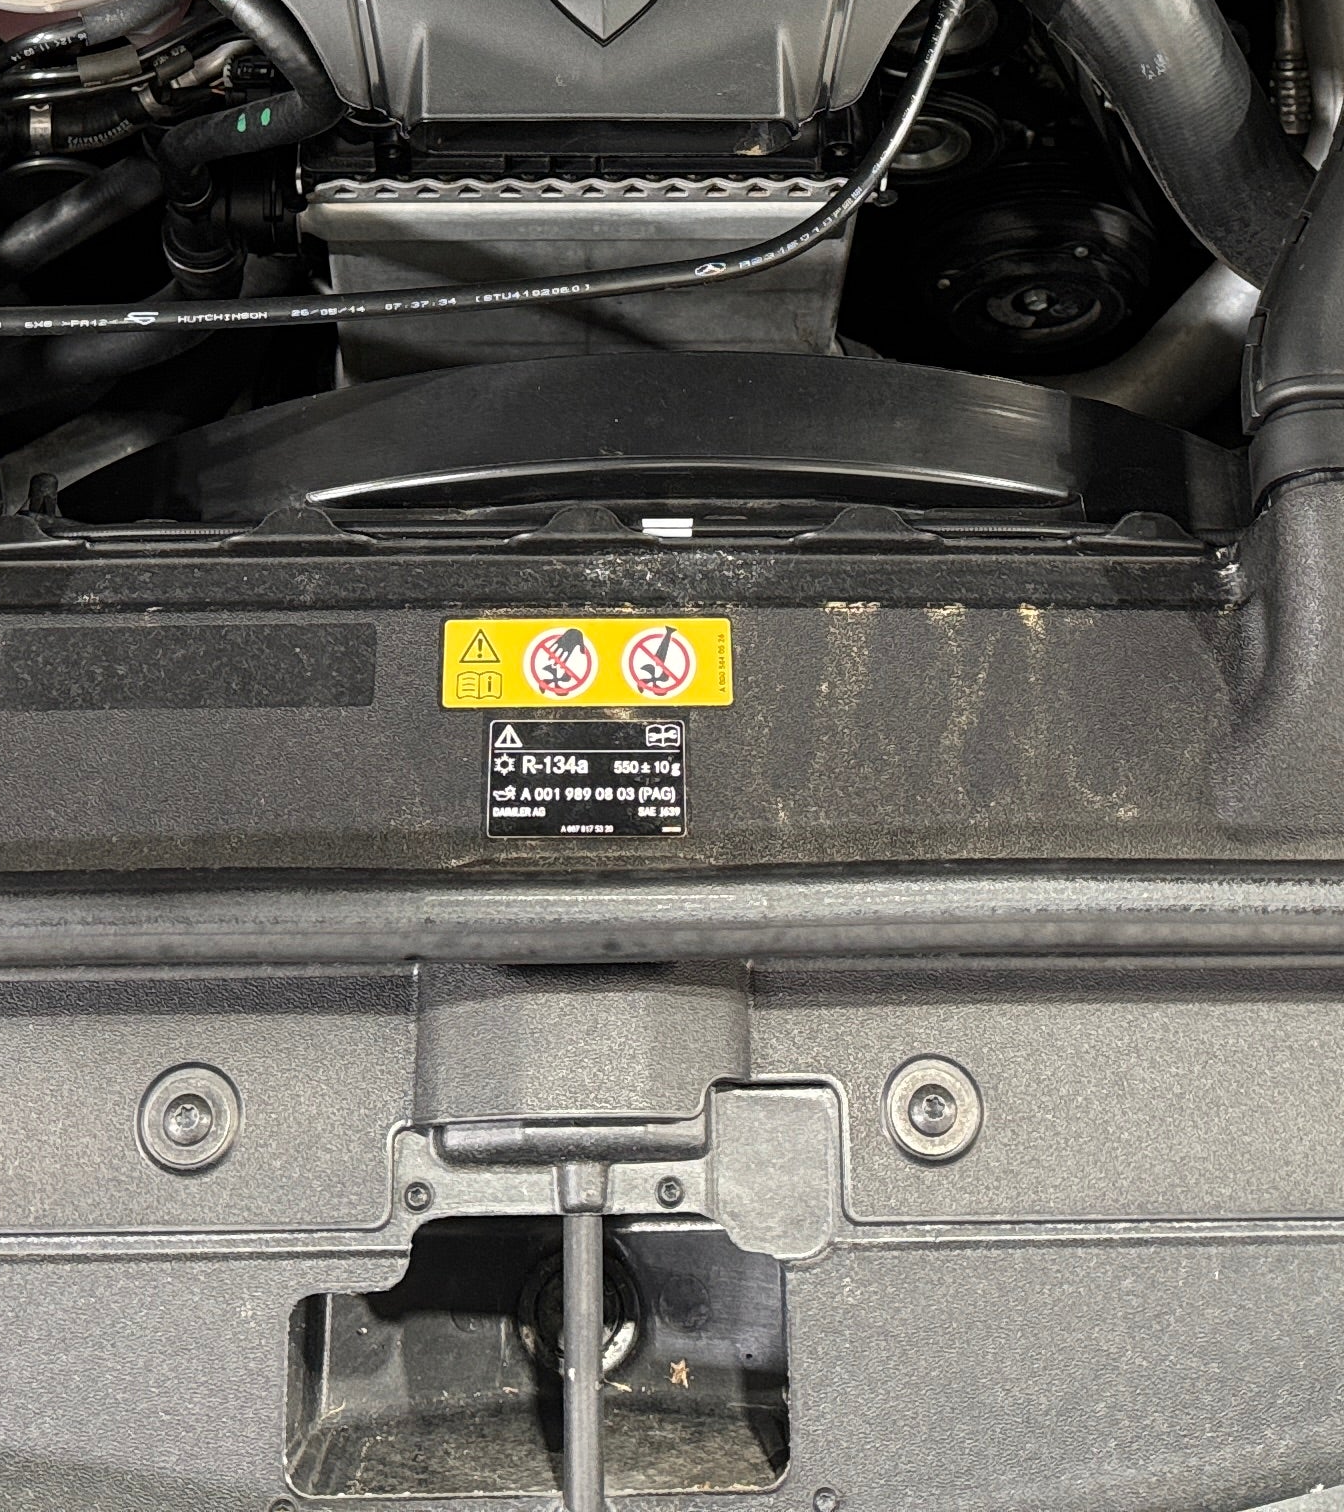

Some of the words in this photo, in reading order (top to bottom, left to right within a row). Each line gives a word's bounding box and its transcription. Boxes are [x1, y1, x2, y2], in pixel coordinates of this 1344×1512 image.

[178, 311, 268, 324] HUTCHINSON
[522, 755, 589, 774] R-134a
[613, 760, 639, 774] 550
[654, 760, 670, 774] 10
[520, 787, 532, 801] A
[534, 787, 560, 801] 001
[564, 787, 592, 801] 989
[594, 787, 614, 801] 08
[616, 787, 635, 801] 03
[638, 786, 676, 803] (PAG)
[638, 806, 657, 817] SAE
